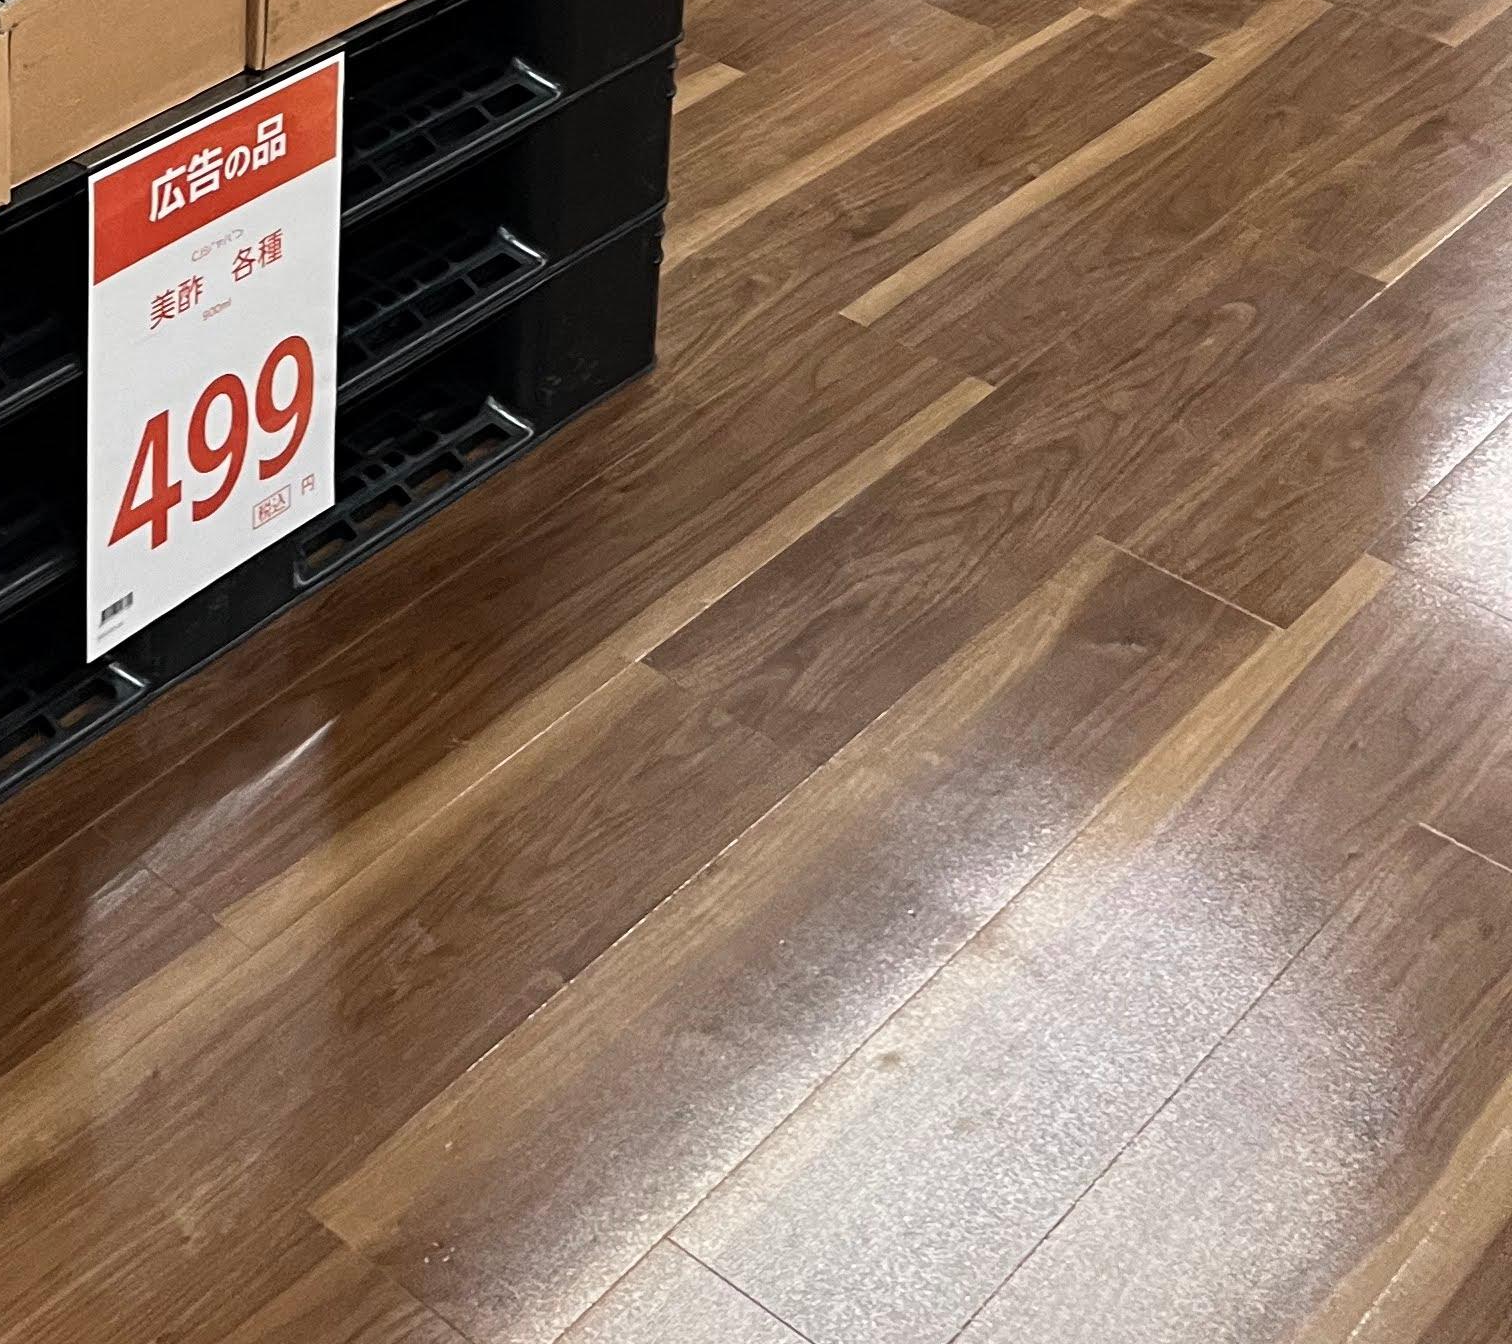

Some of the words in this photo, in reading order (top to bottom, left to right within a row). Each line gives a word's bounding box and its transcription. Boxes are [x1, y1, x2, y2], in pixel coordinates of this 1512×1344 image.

[149, 112, 287, 223] 広告の品
[150, 275, 204, 330] 美酢
[232, 228, 283, 281] 各種
[107, 334, 314, 550] 499
[300, 474, 315, 494] 円
